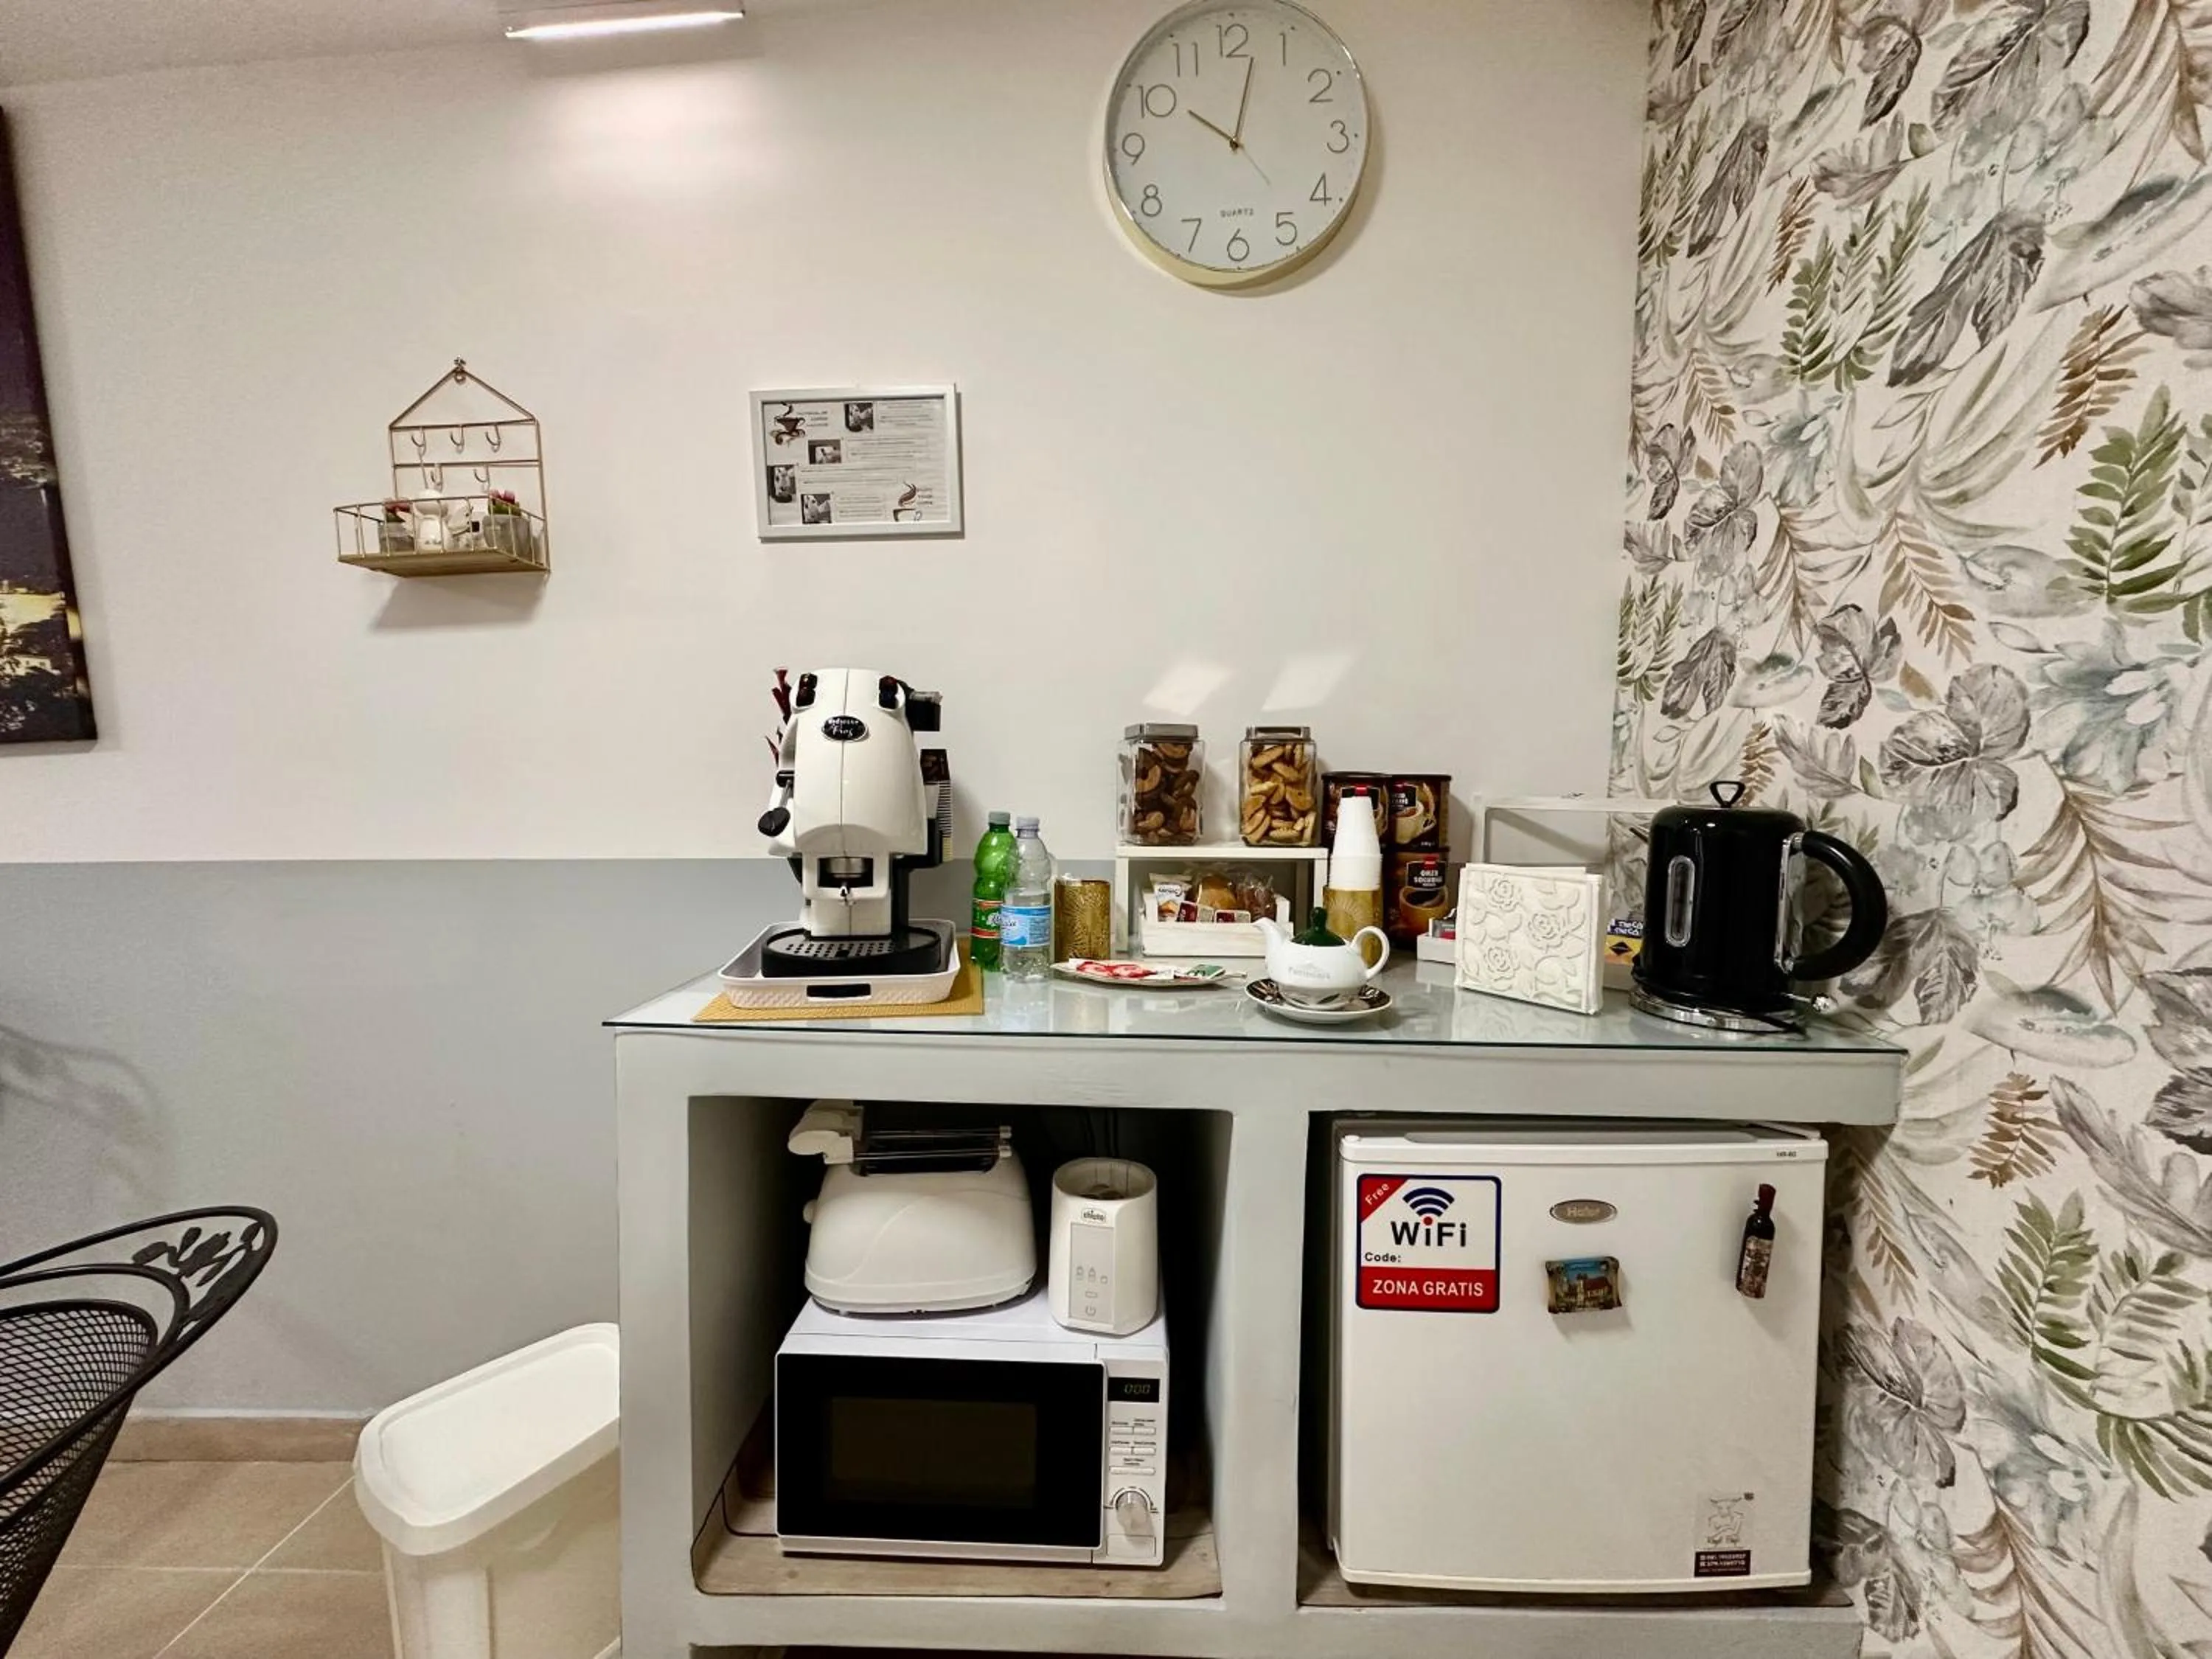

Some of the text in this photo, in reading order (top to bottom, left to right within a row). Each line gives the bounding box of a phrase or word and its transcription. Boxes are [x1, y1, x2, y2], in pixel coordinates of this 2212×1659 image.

[1216, 23, 1250, 58] 12
[1279, 32, 1287, 67] 1
[1172, 41, 1199, 78] 11
[1138, 83, 1178, 119] 10
[1307, 68, 1334, 103] 2
[1121, 132, 1146, 166] 9
[1326, 119, 1349, 154] 3
[1141, 184, 1163, 218] 8
[1308, 172, 1333, 206] 4
[1219, 207, 1255, 219] QUARTZ
[1275, 211, 1298, 246] 5
[1180, 217, 1203, 254] 7
[1226, 227, 1251, 262] 6
[1365, 1182, 1390, 1206] Free
[1390, 1216, 1467, 1248] WiFi
[1364, 1251, 1402, 1263] Code:
[1372, 1279, 1484, 1298] ZONA GRATIS
